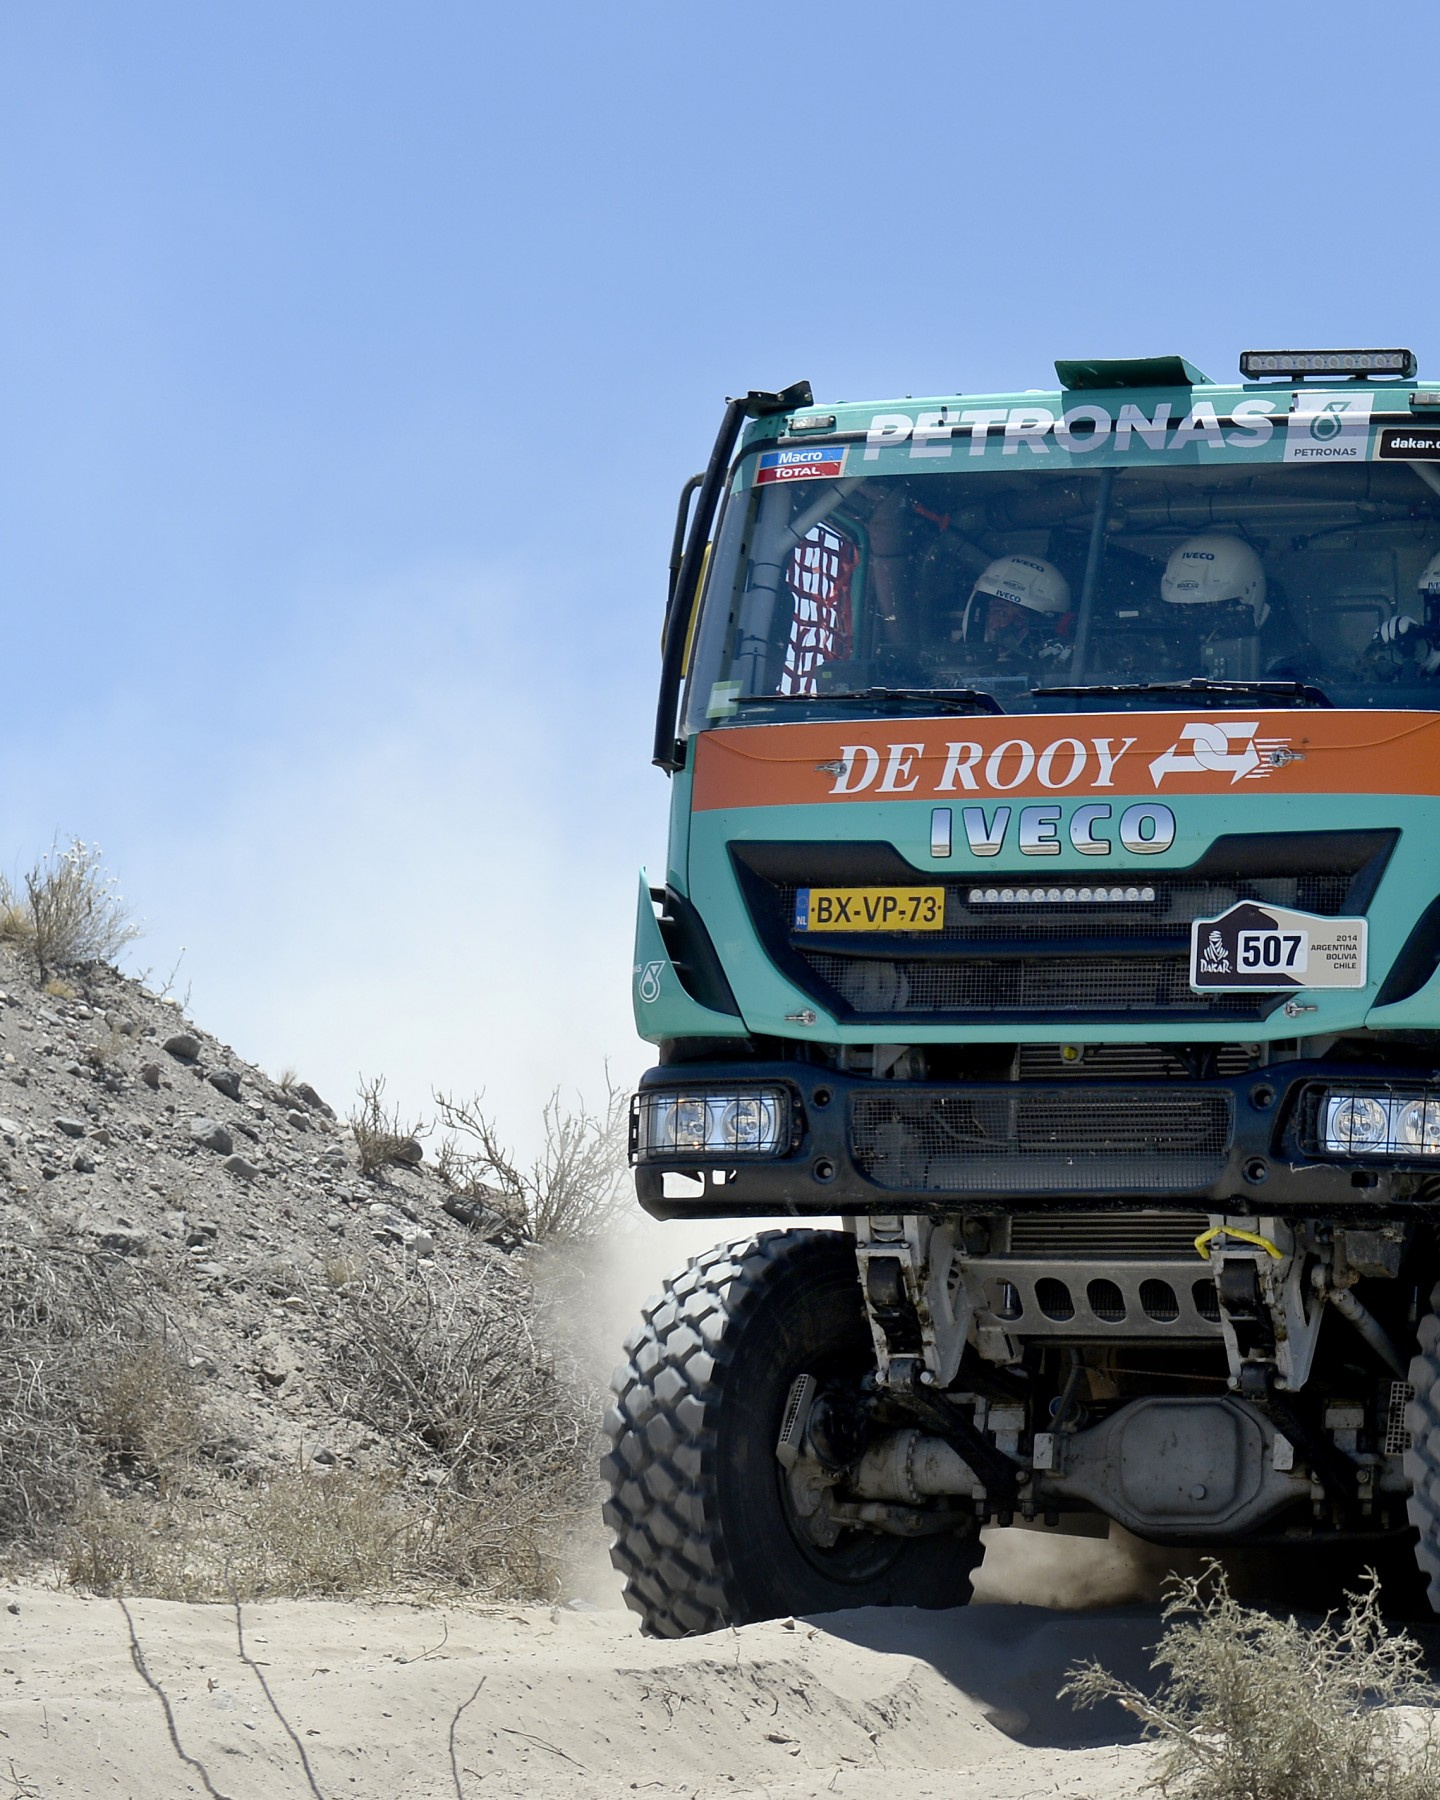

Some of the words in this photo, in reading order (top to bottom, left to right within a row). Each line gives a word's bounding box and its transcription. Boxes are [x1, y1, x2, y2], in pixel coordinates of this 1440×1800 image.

[863, 399, 1277, 461] PETRONAS
[779, 451, 823, 464] Macro
[1294, 448, 1357, 457] PETRONAS
[774, 466, 821, 478] TOTAL
[1182, 552, 1215, 561] IVECO
[1010, 558, 1045, 573] IVECO
[996, 589, 1022, 603] IVECO
[828, 743, 925, 794] DE
[933, 737, 1137, 791] ROOY
[930, 802, 1177, 860] IVECO
[817, 896, 937, 923] BX-VP-73
[796, 916, 807, 925] NL
[1336, 934, 1358, 942] 2014
[1242, 935, 1302, 967] 507
